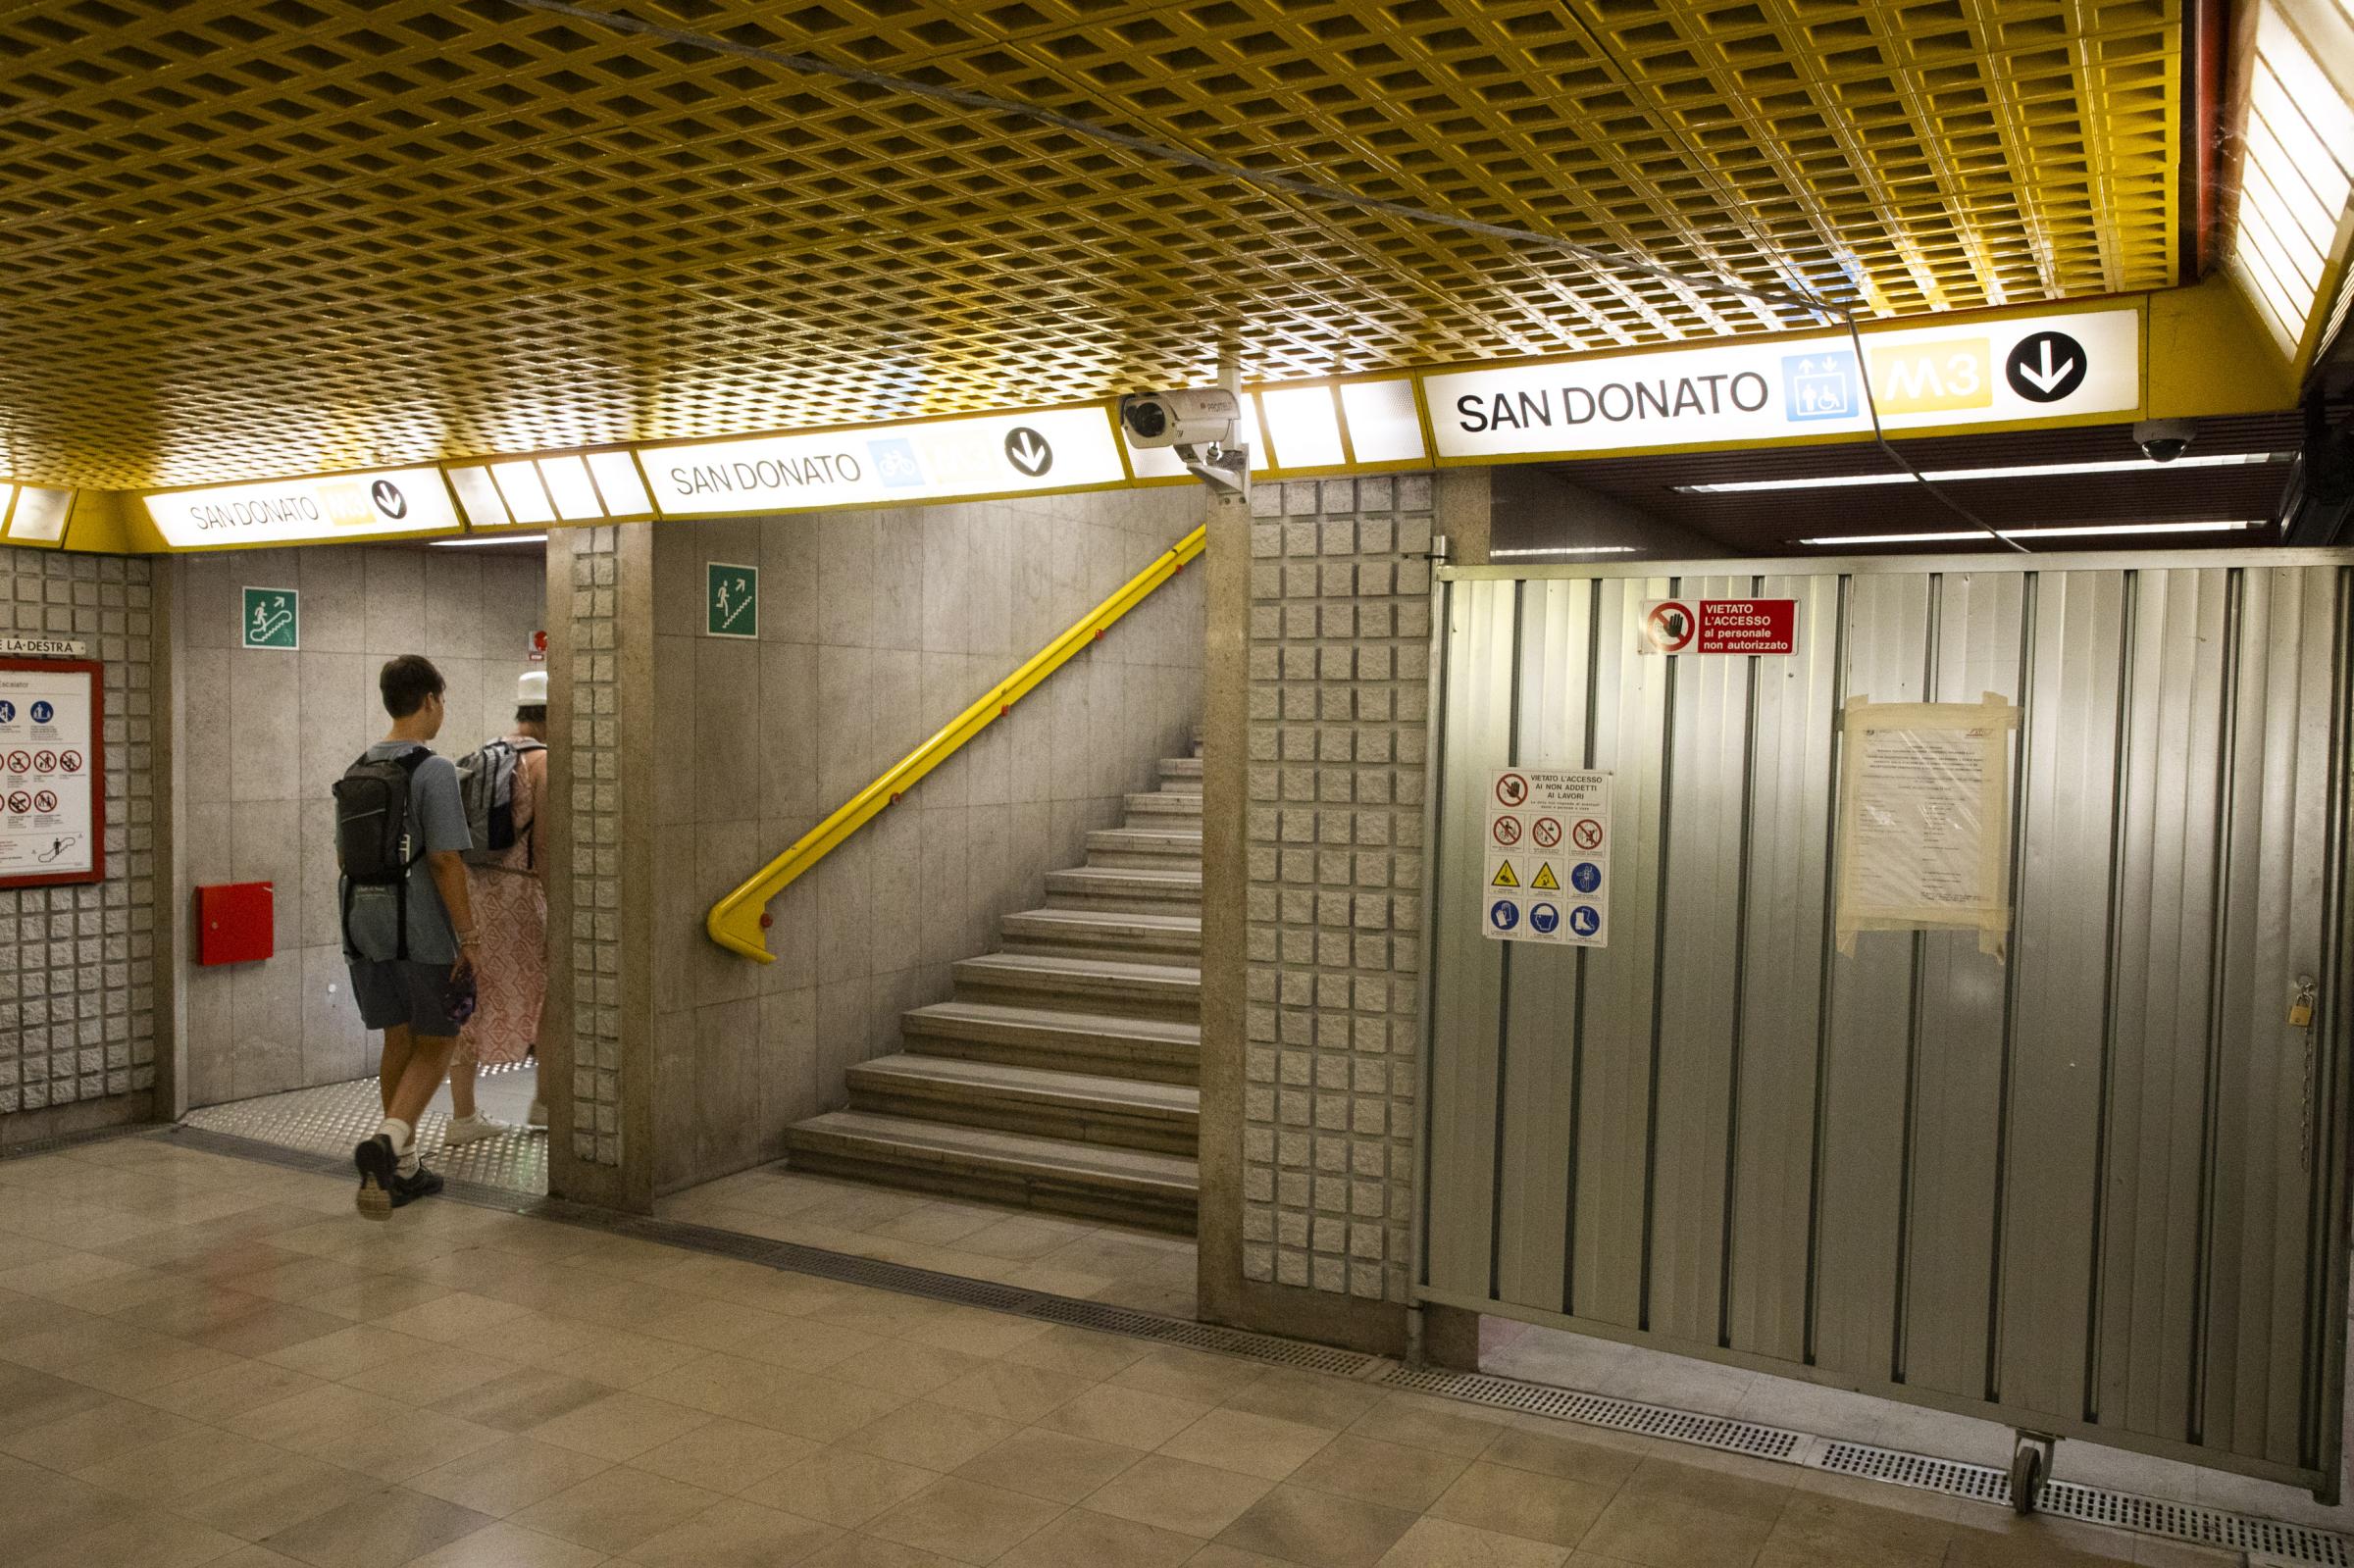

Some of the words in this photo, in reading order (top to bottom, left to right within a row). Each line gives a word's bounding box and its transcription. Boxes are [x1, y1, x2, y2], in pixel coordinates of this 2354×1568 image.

[1884, 353, 1980, 401] M3
[1457, 389, 1552, 432] SAN
[1561, 372, 1768, 425] DONATO
[671, 464, 733, 495] SAN
[733, 453, 861, 490] DONATO
[190, 504, 236, 531] SAN
[233, 496, 319, 527] DONATO
[1705, 604, 1754, 614] VIETATO
[1704, 616, 1771, 627] L'ACCESSO
[1704, 628, 1714, 637] al
[1717, 629, 1771, 639] personale
[7, 639, 23, 651] LA
[27, 640, 74, 653] DESTRA
[1704, 641, 1723, 650] non
[1727, 639, 1788, 650] autorizzato
